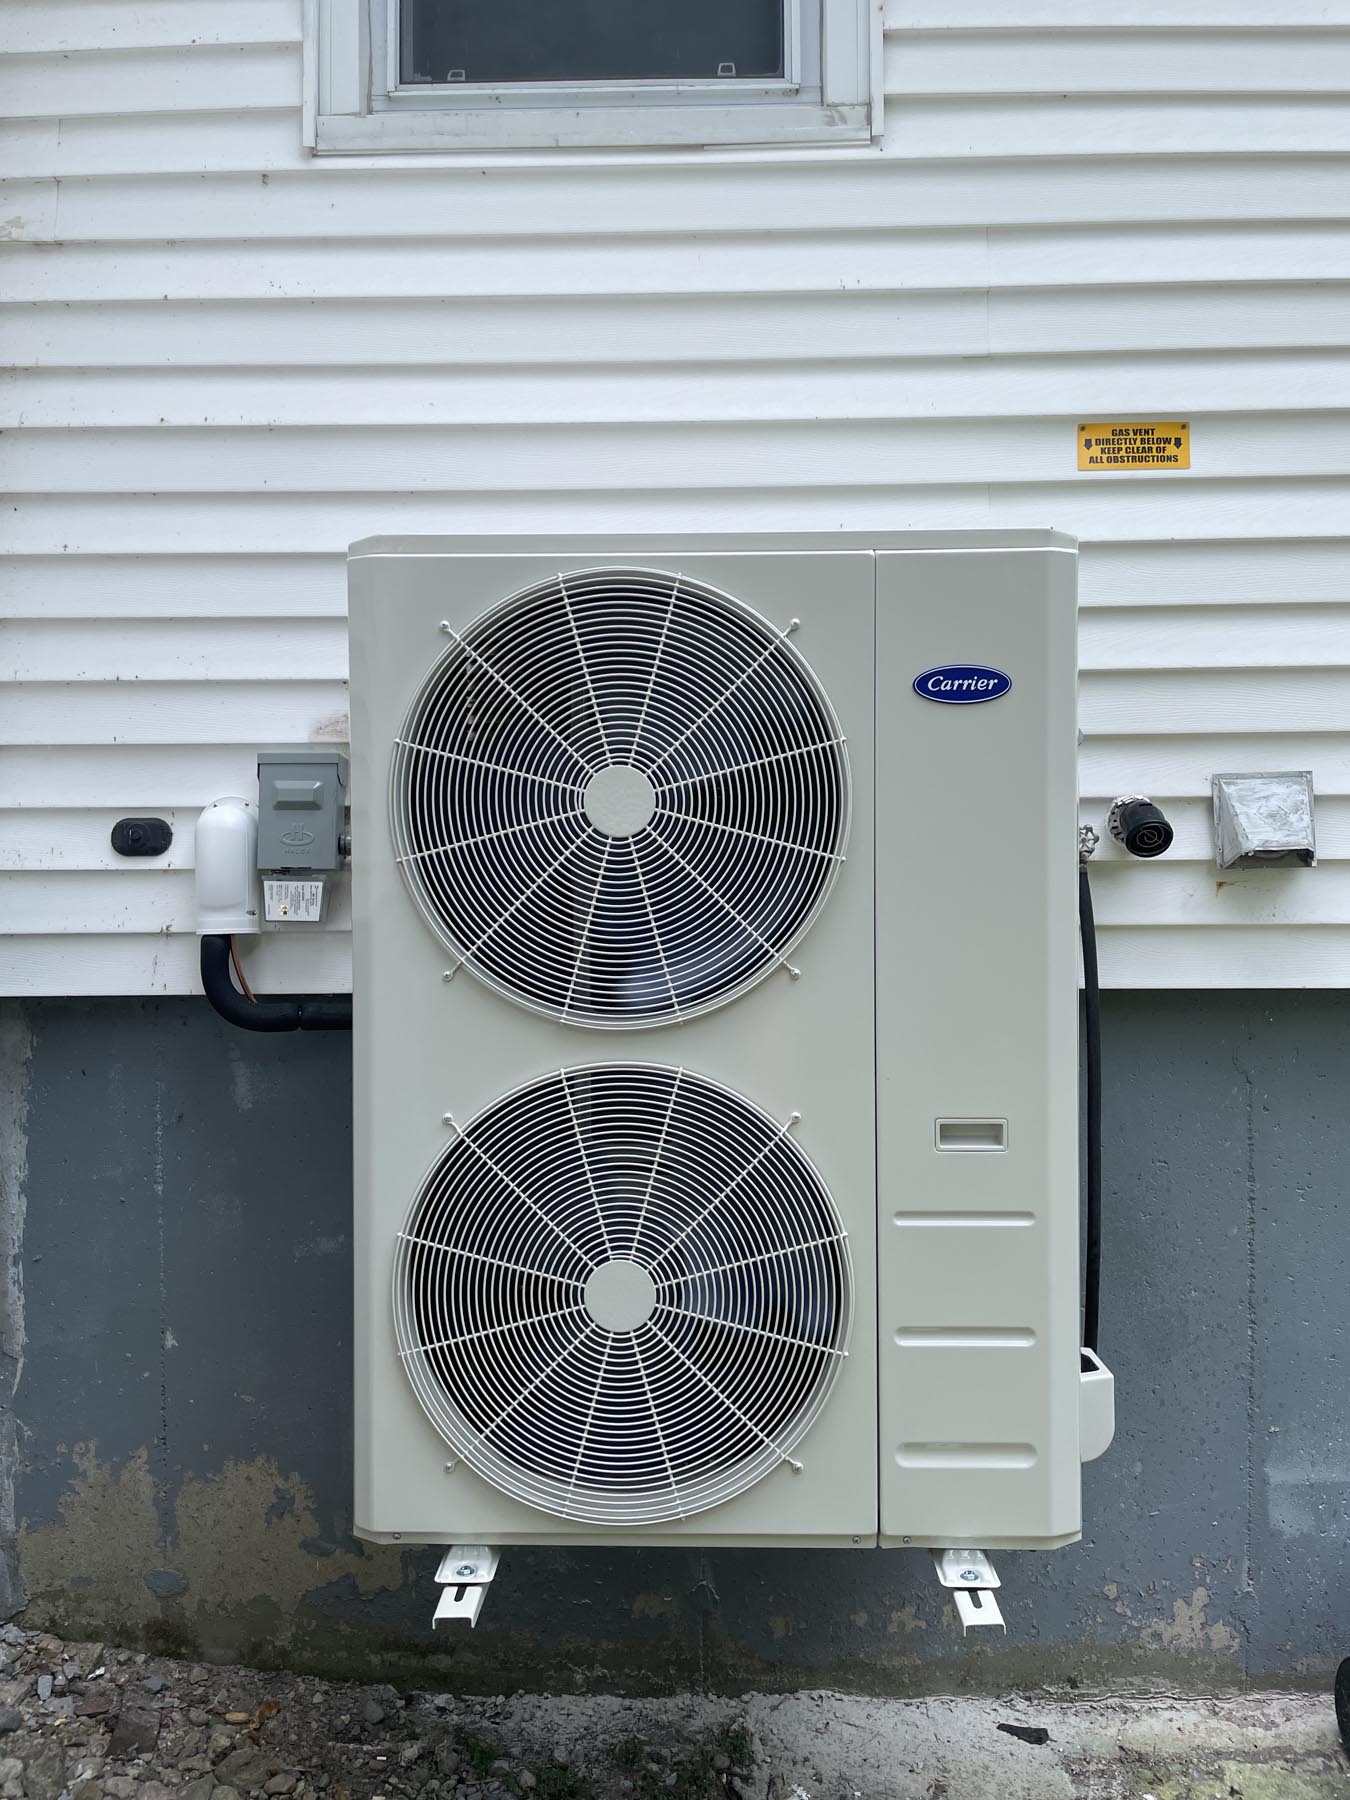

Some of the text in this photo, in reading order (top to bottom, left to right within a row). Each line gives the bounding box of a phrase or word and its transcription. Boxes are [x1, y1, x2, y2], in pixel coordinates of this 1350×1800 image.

[1111, 428, 1155, 437] GAS VENT
[1095, 437, 1172, 446] DIRECTLY BELOW
[1125, 446, 1153, 454] CLEAR
[1156, 446, 1166, 454] OF
[1089, 455, 1178, 464] ALL OBSTRUCTIONS
[927, 676, 998, 691] Carrier
